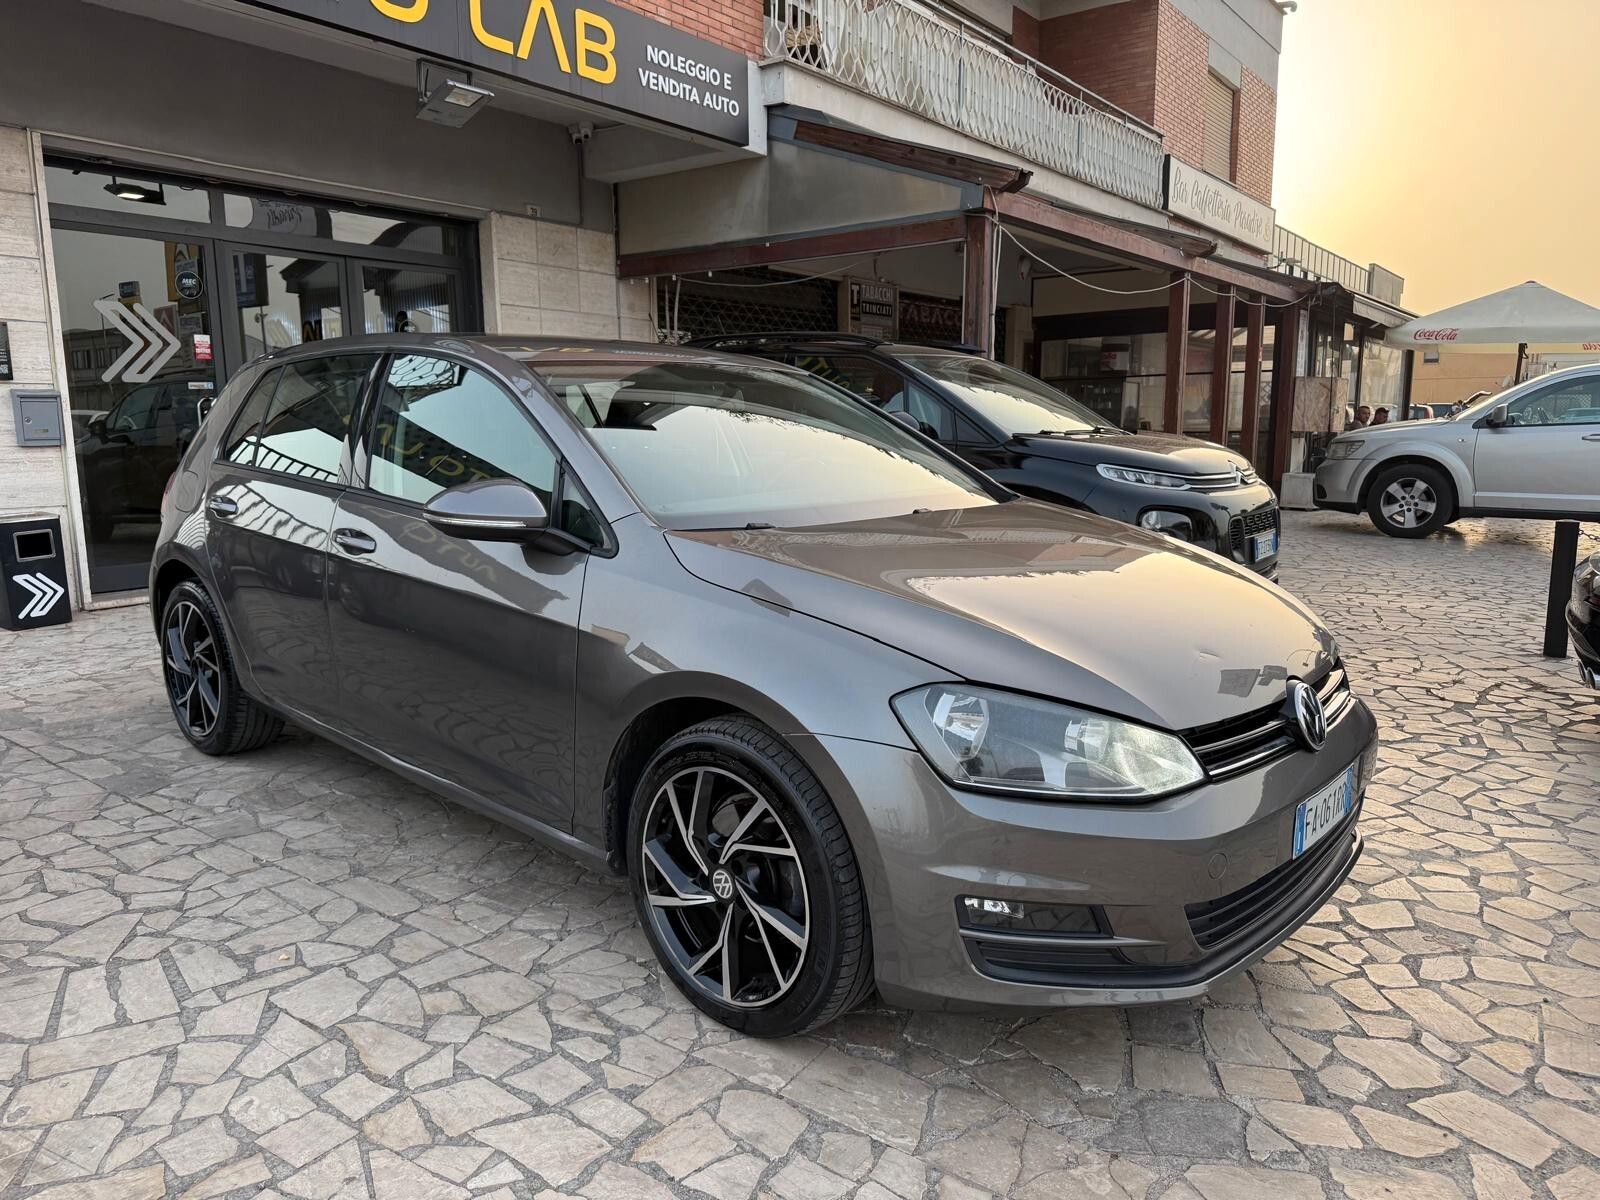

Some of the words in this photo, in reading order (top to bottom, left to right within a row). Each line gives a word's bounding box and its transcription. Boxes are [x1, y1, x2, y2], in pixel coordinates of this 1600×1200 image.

[646, 44, 720, 86] NOLEGGIO
[723, 72, 732, 90] E
[638, 67, 700, 104] VENDITA
[703, 91, 740, 116] AUTO
[1172, 166, 1188, 204] Bar
[861, 285, 893, 302] TABACCHI
